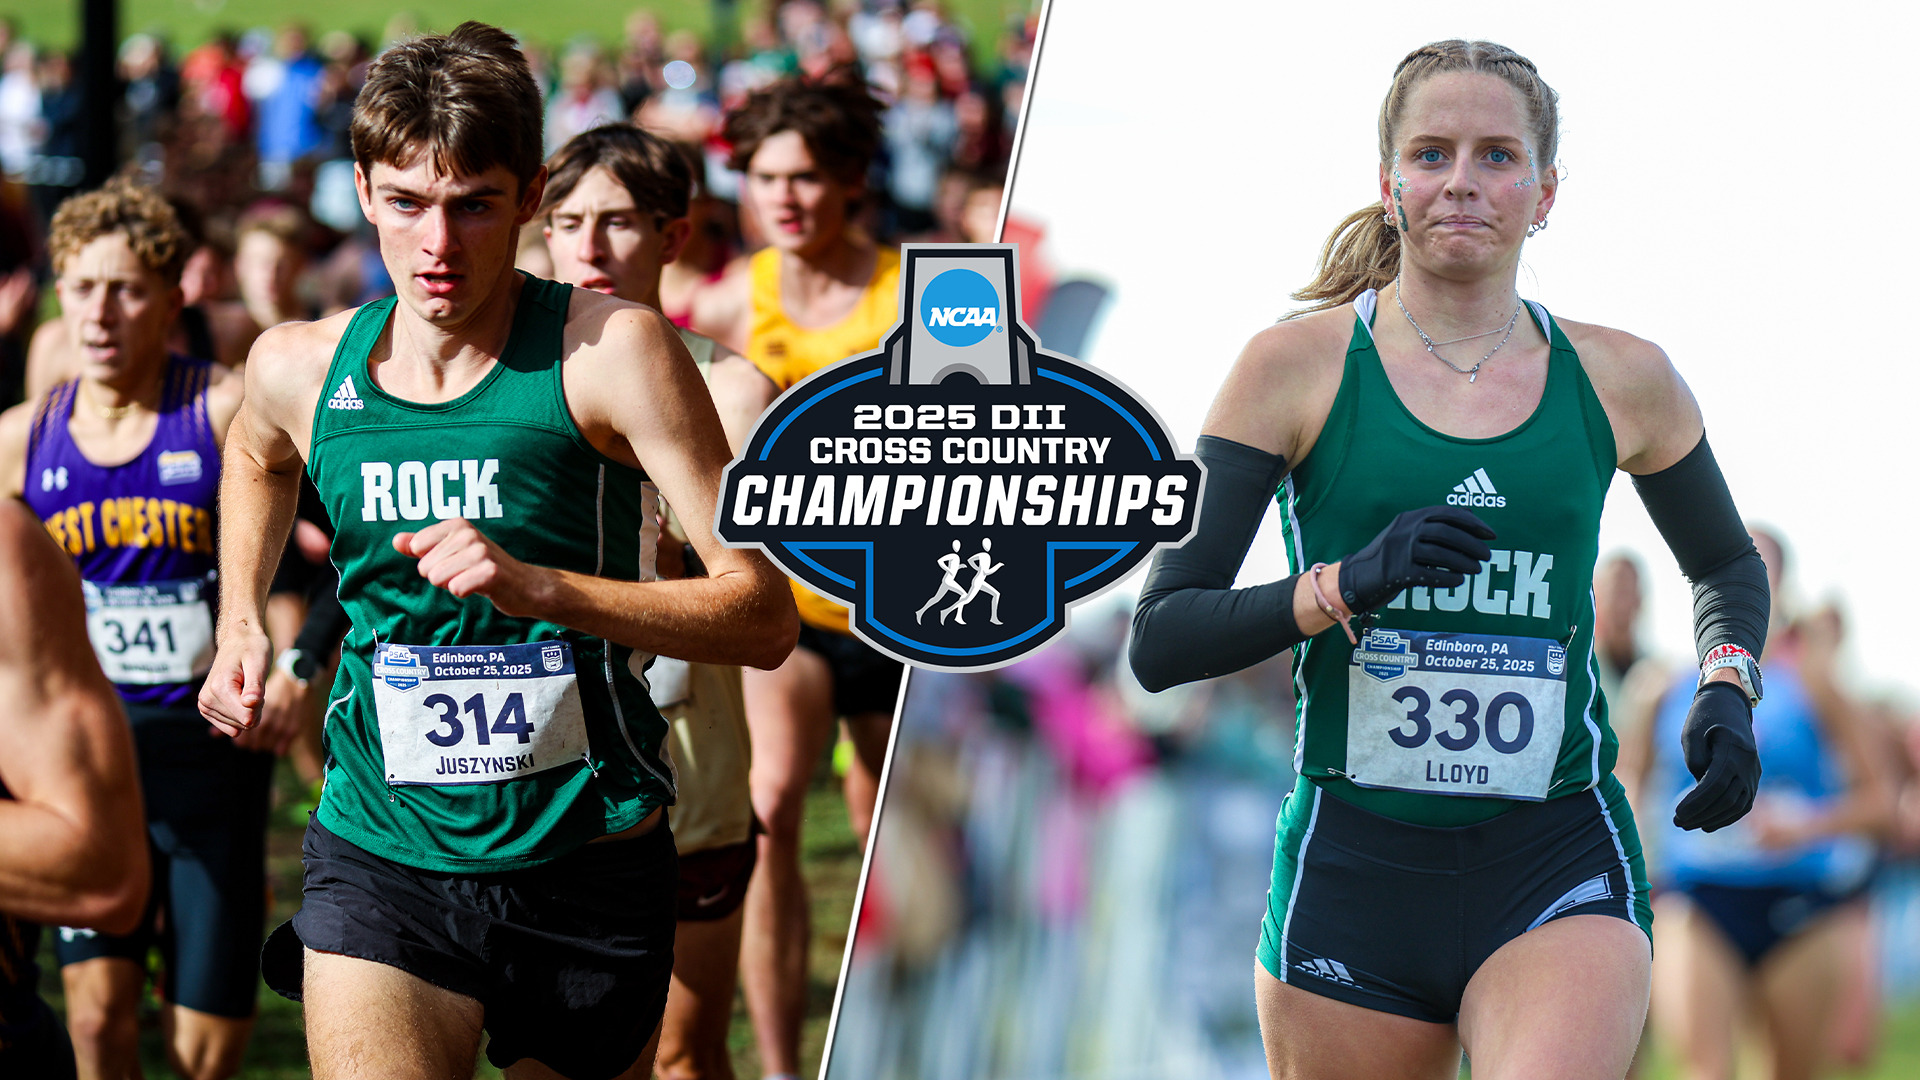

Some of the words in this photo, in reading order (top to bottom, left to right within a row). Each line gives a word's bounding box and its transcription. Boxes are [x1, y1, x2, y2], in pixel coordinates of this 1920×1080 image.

[328, 397, 364, 410] adidas
[360, 458, 503, 521] ROCK
[1446, 491, 1506, 508] adidas
[45, 501, 96, 556] EST
[103, 617, 177, 654] 341
[1371, 635, 1399, 644] PSAC
[389, 651, 409, 659] PSAC
[1425, 639, 1488, 655] Edinboro,
[1491, 643, 1509, 655] PA
[432, 652, 487, 664] Edinboro,
[489, 652, 505, 662] PA
[1355, 652, 1378, 661] CROSS
[1379, 654, 1416, 664] COUNTRY
[1425, 655, 1478, 668] October
[1480, 658, 1499, 671] 25,
[1502, 659, 1535, 672] 2025
[376, 666, 396, 674] CROSS
[396, 668, 427, 676] COUNTRY
[434, 665, 481, 676] October
[483, 665, 500, 676] 25,
[503, 664, 532, 675] 2025
[423, 692, 535, 747] 314
[1388, 685, 1534, 755] 330
[436, 753, 535, 775] JUSZYNSKI
[1426, 760, 1489, 785] LLOYD
